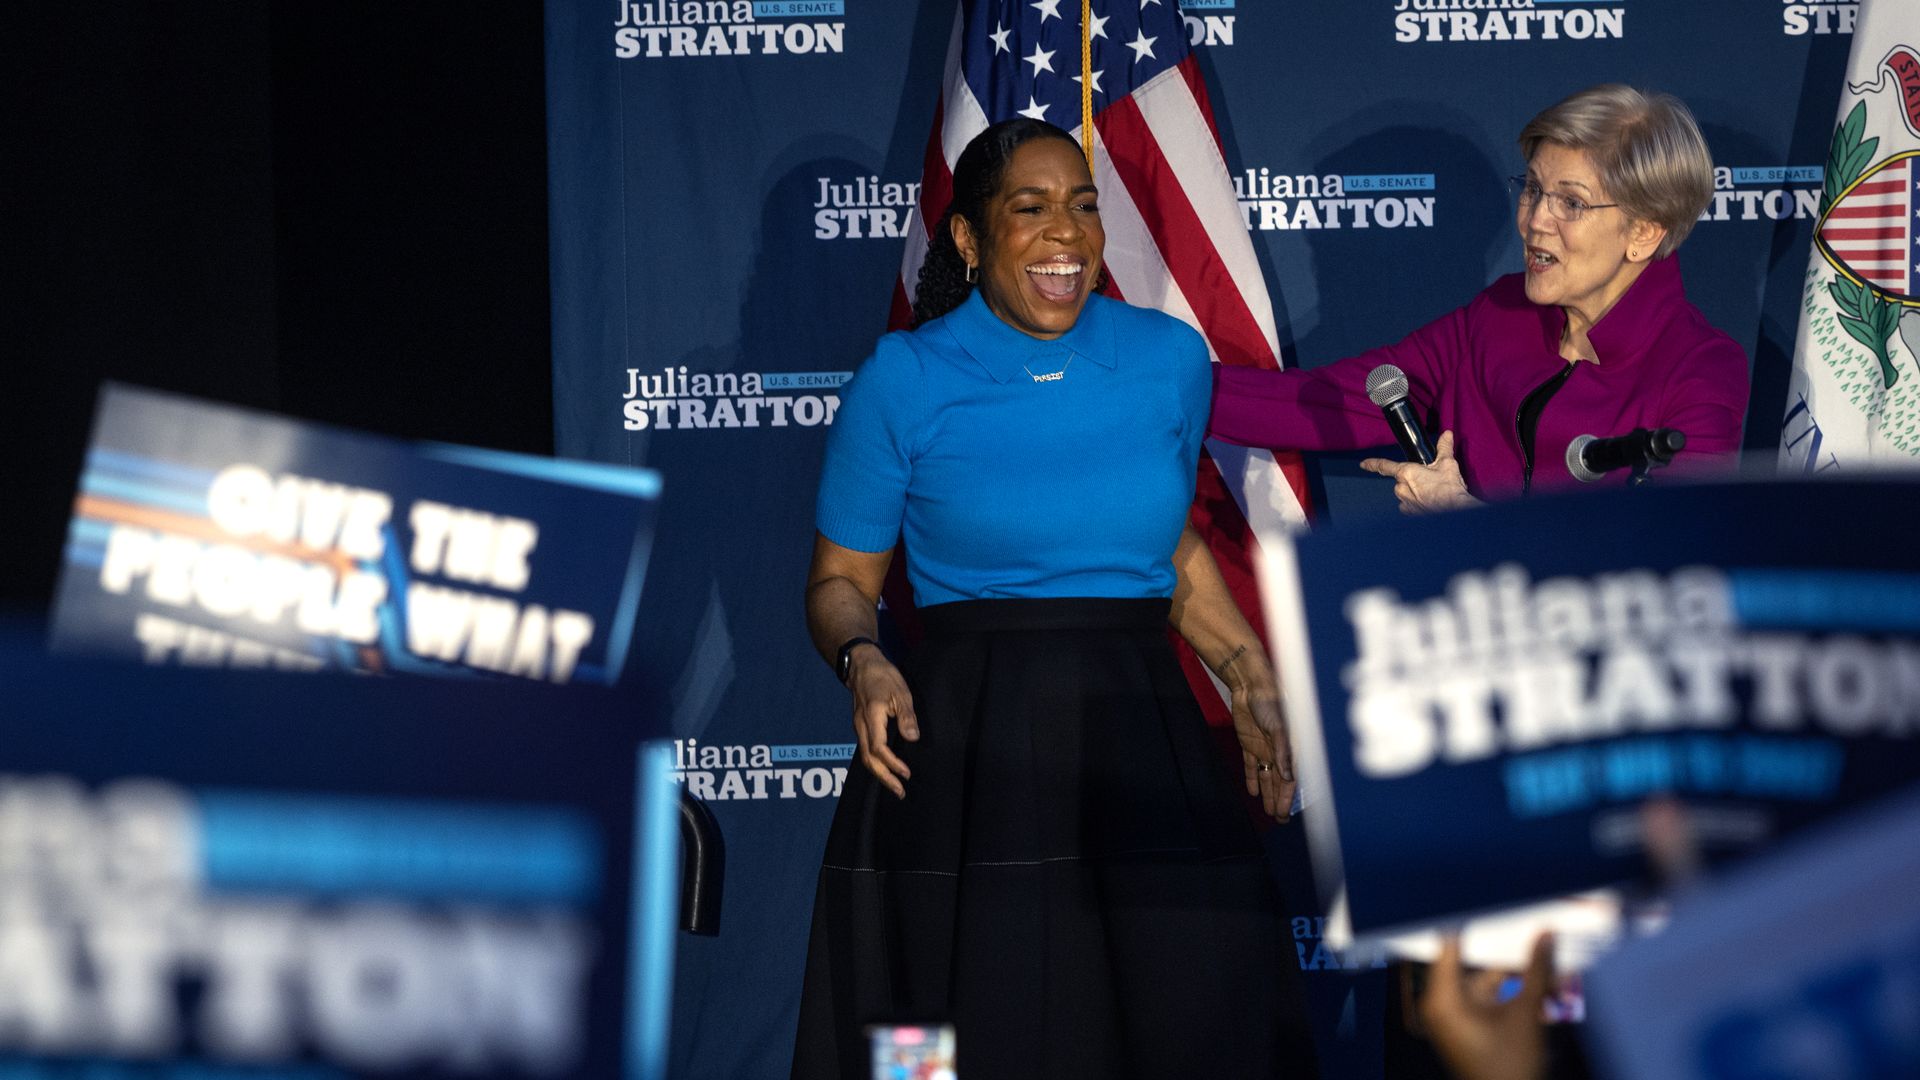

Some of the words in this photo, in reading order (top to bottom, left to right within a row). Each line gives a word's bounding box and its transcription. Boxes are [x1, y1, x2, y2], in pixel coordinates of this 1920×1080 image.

[615, 0, 755, 26] Juliana
[761, 4, 784, 14] U.S.
[789, 3, 836, 13] SENATE
[615, 23, 845, 58] STRATTON
[1395, 8, 1625, 43] STRATTON
[1233, 167, 1345, 199] liana
[1351, 179, 1374, 188] U.S.
[1380, 177, 1426, 187] SENATE
[1740, 171, 1763, 180] U.S.
[1768, 169, 1815, 179] SENATE
[814, 175, 920, 208] Julia
[1238, 197, 1435, 230] TRATTON
[623, 366, 764, 399] Juliana
[770, 375, 793, 386] U.S.
[798, 374, 845, 385] SENATE
[410, 500, 539, 592] THE
[407, 582, 594, 683] WHAT
[1345, 566, 1736, 684] Juliana
[1350, 635, 1920, 776] STRATTO
[672, 738, 773, 769] liana
[779, 749, 802, 758] U.S.
[807, 748, 854, 757] SENATE
